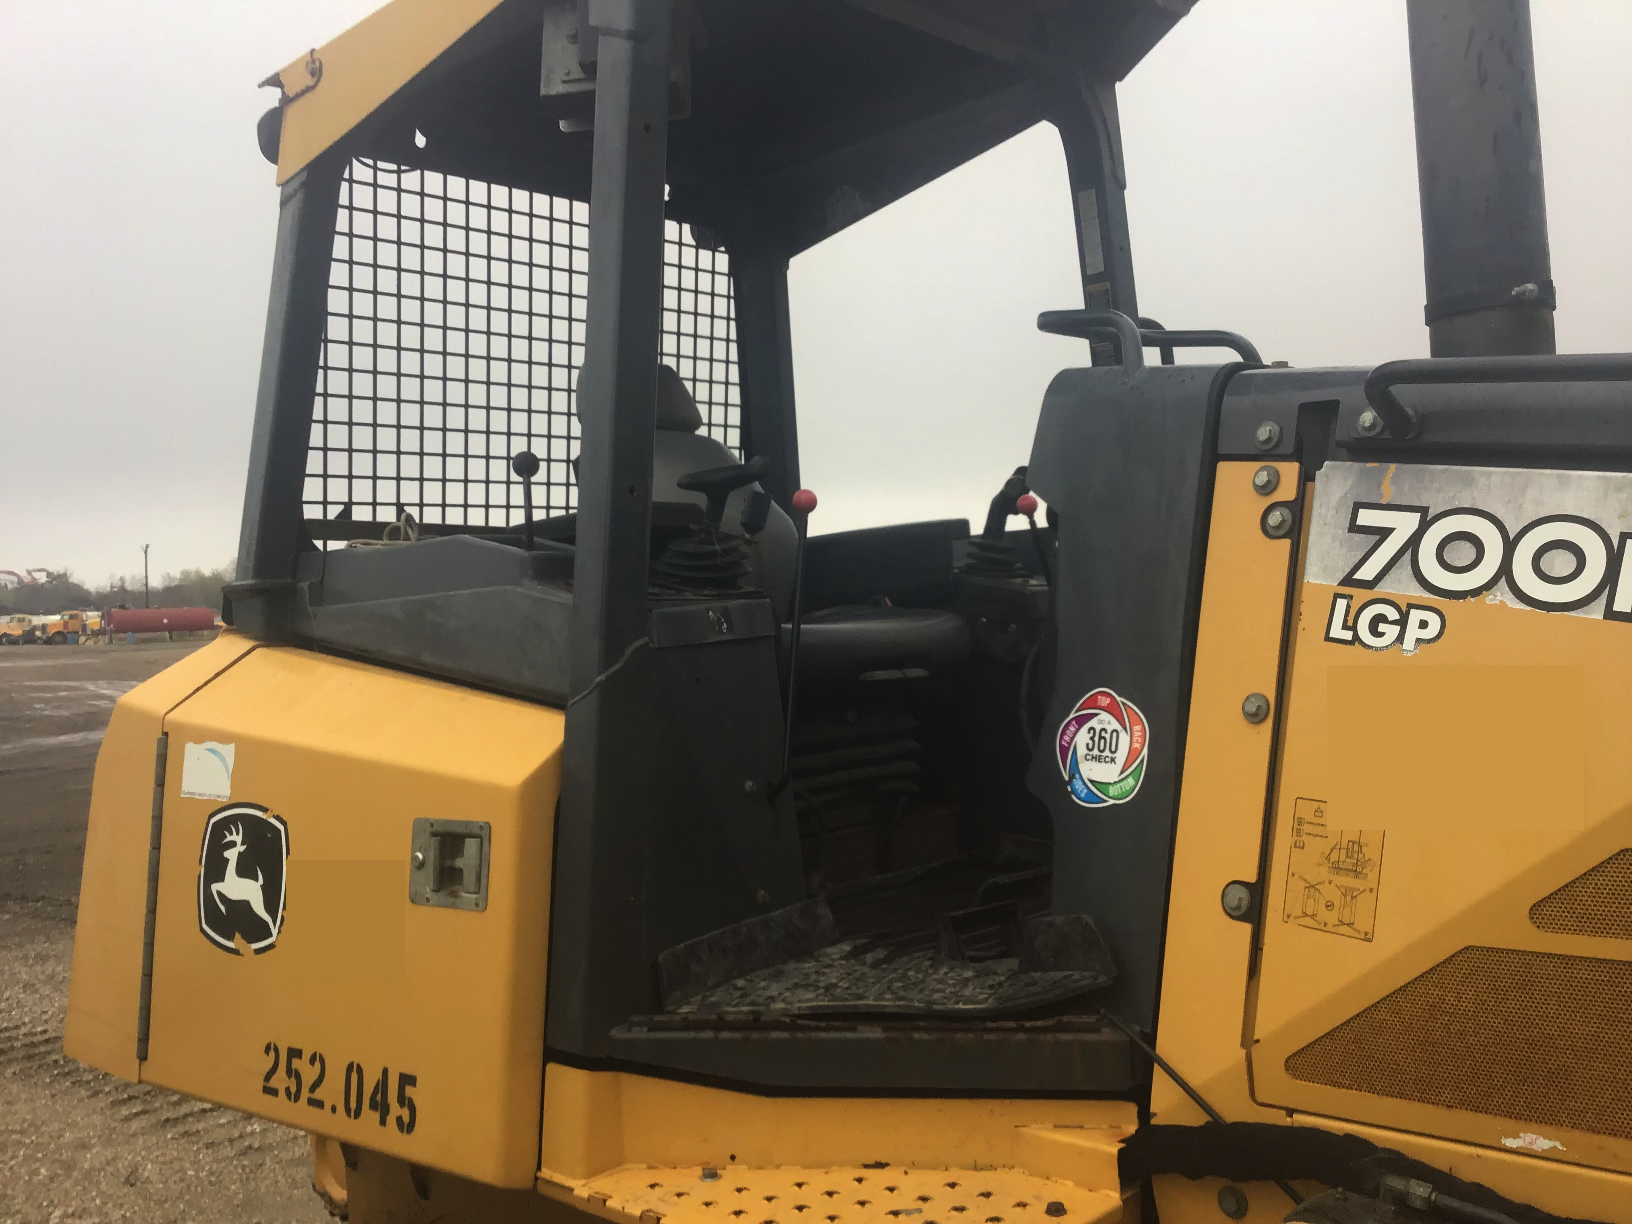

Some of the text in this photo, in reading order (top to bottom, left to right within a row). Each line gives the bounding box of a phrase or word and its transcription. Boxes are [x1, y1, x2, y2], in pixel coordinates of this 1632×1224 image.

[1324, 593, 1446, 655] LGP
[1097, 695, 1111, 707] TOP
[1061, 720, 1079, 747] FRONT
[1132, 724, 1142, 749] BACK
[1084, 753, 1117, 765] CHECK
[1109, 776, 1136, 797] BOTTOM
[262, 1041, 418, 1136] 252.045
